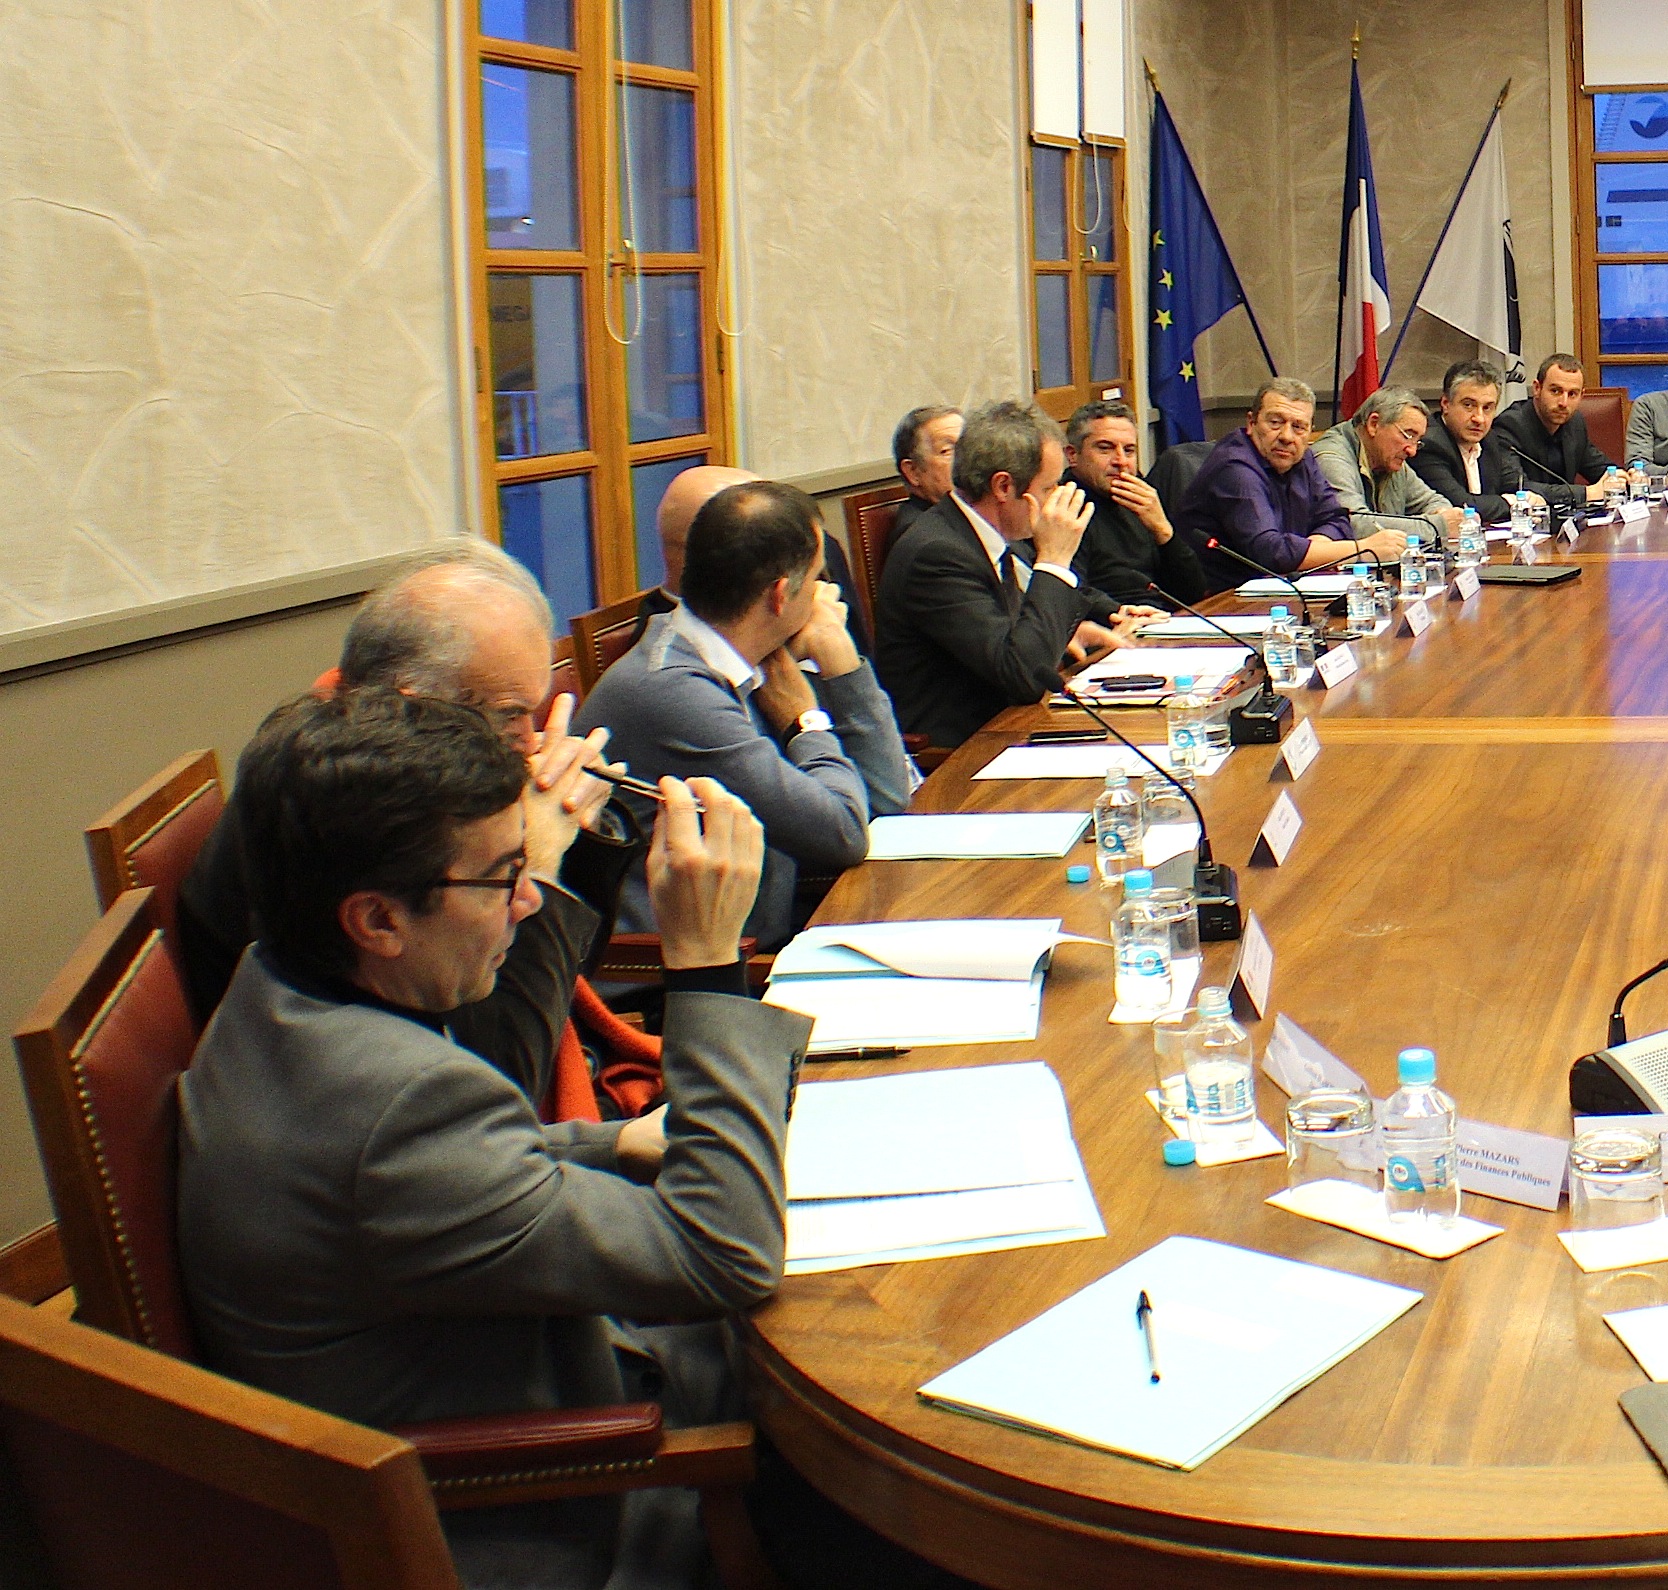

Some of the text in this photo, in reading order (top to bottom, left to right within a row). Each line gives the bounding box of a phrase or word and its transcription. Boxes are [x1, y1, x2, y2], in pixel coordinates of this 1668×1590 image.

[1481, 1149, 1520, 1166] MAZARS
[1460, 1158, 1551, 1186] des Finances Publiques
